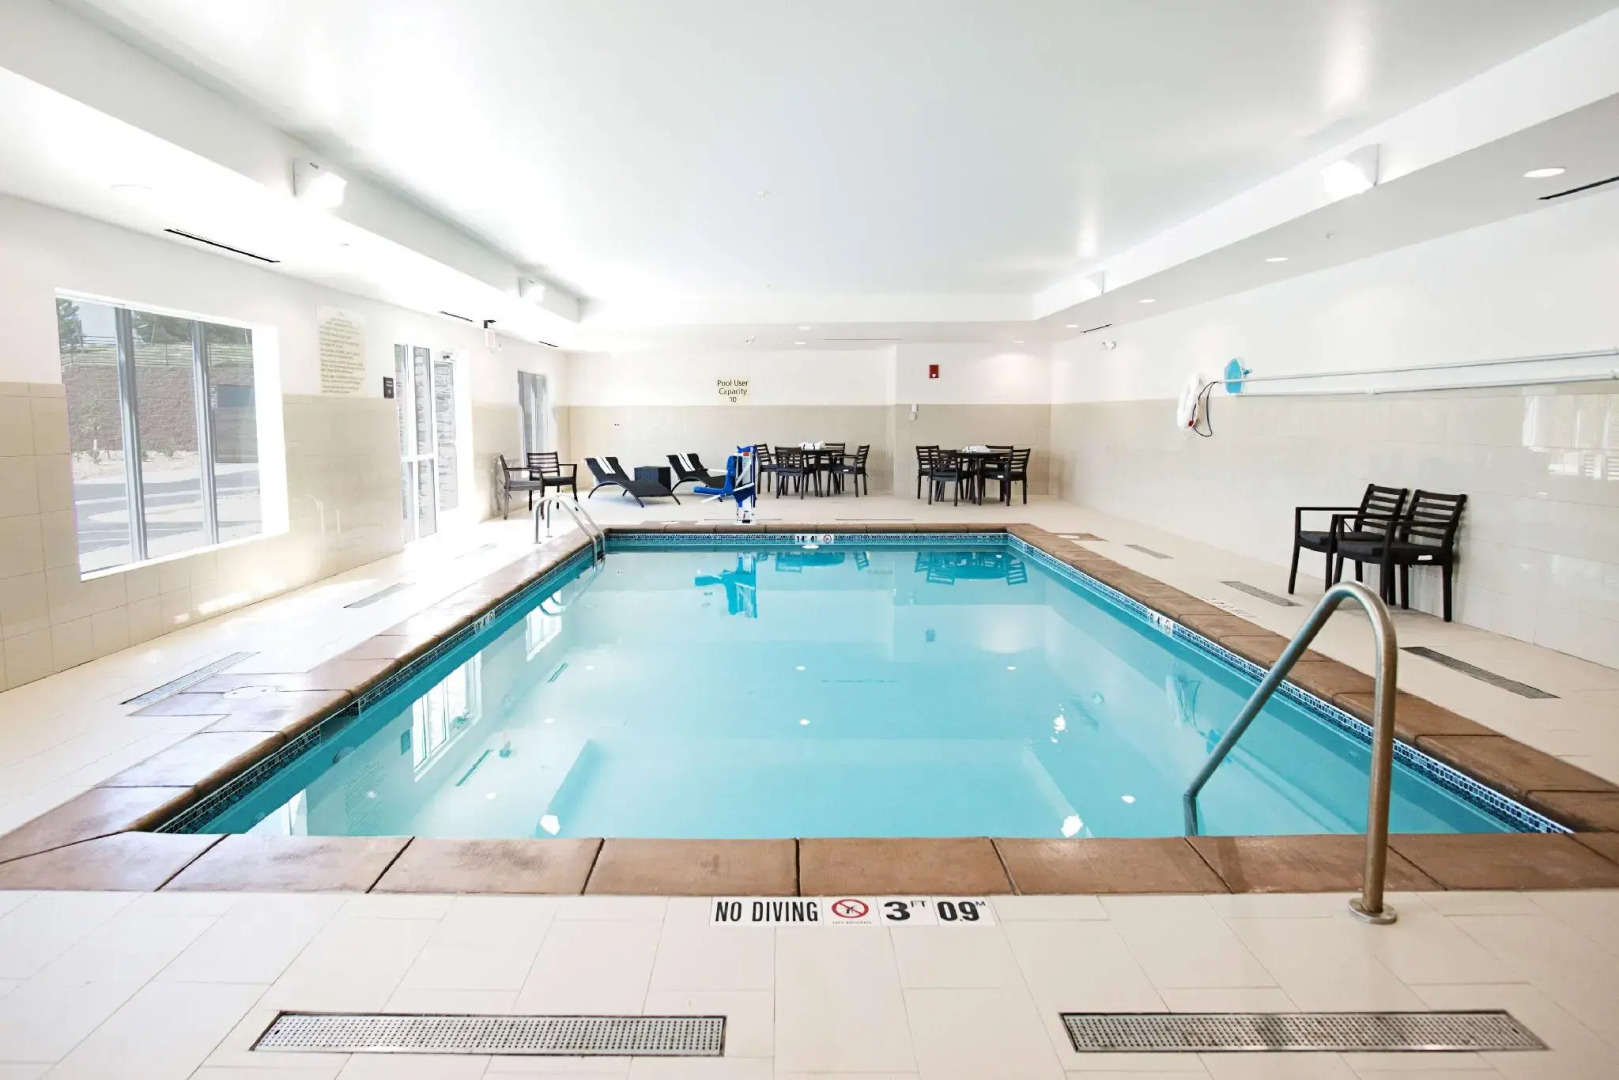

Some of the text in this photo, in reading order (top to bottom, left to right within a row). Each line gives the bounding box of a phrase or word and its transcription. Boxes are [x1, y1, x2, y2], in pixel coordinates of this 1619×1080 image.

[717, 379, 749, 387] Pool User
[718, 387, 748, 396] Capacity
[715, 901, 742, 921] NO
[752, 901, 818, 921] DIVING
